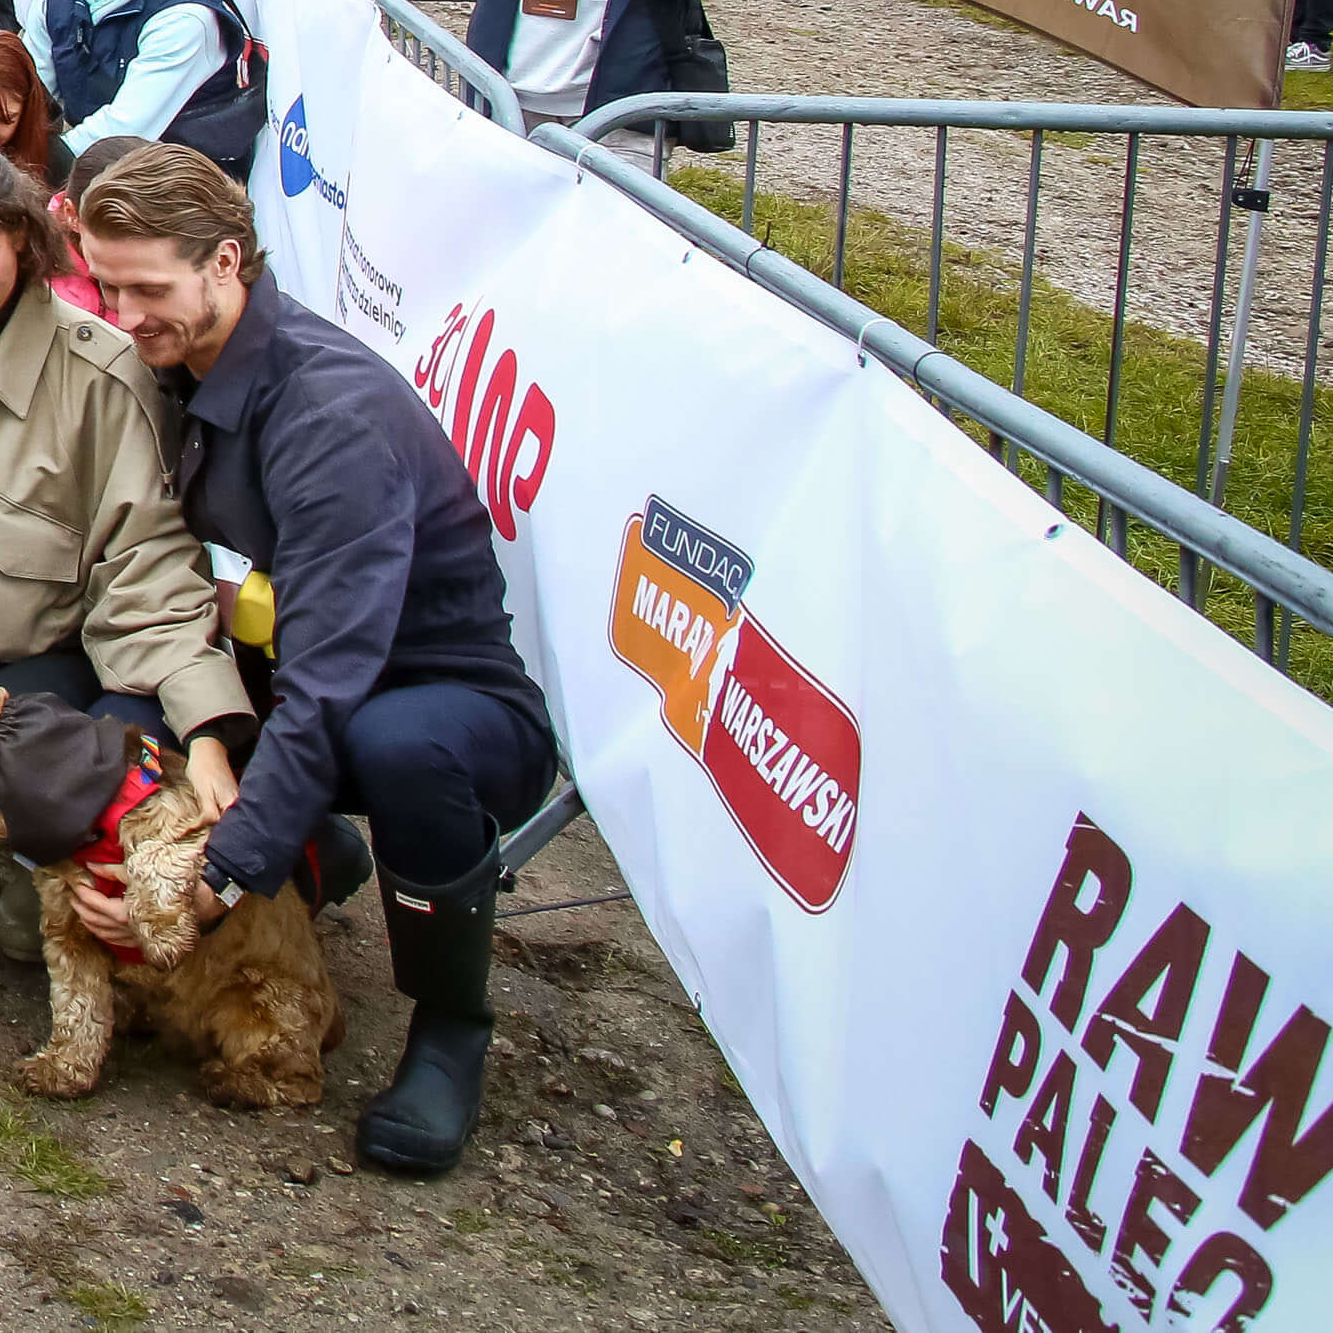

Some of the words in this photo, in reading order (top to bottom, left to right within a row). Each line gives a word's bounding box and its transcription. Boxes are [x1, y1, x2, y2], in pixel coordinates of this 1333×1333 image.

[648, 512, 741, 597] FUNDAC
[720, 675, 856, 855] WARSZAWSKI
[1020, 809, 1333, 1233] RAW
